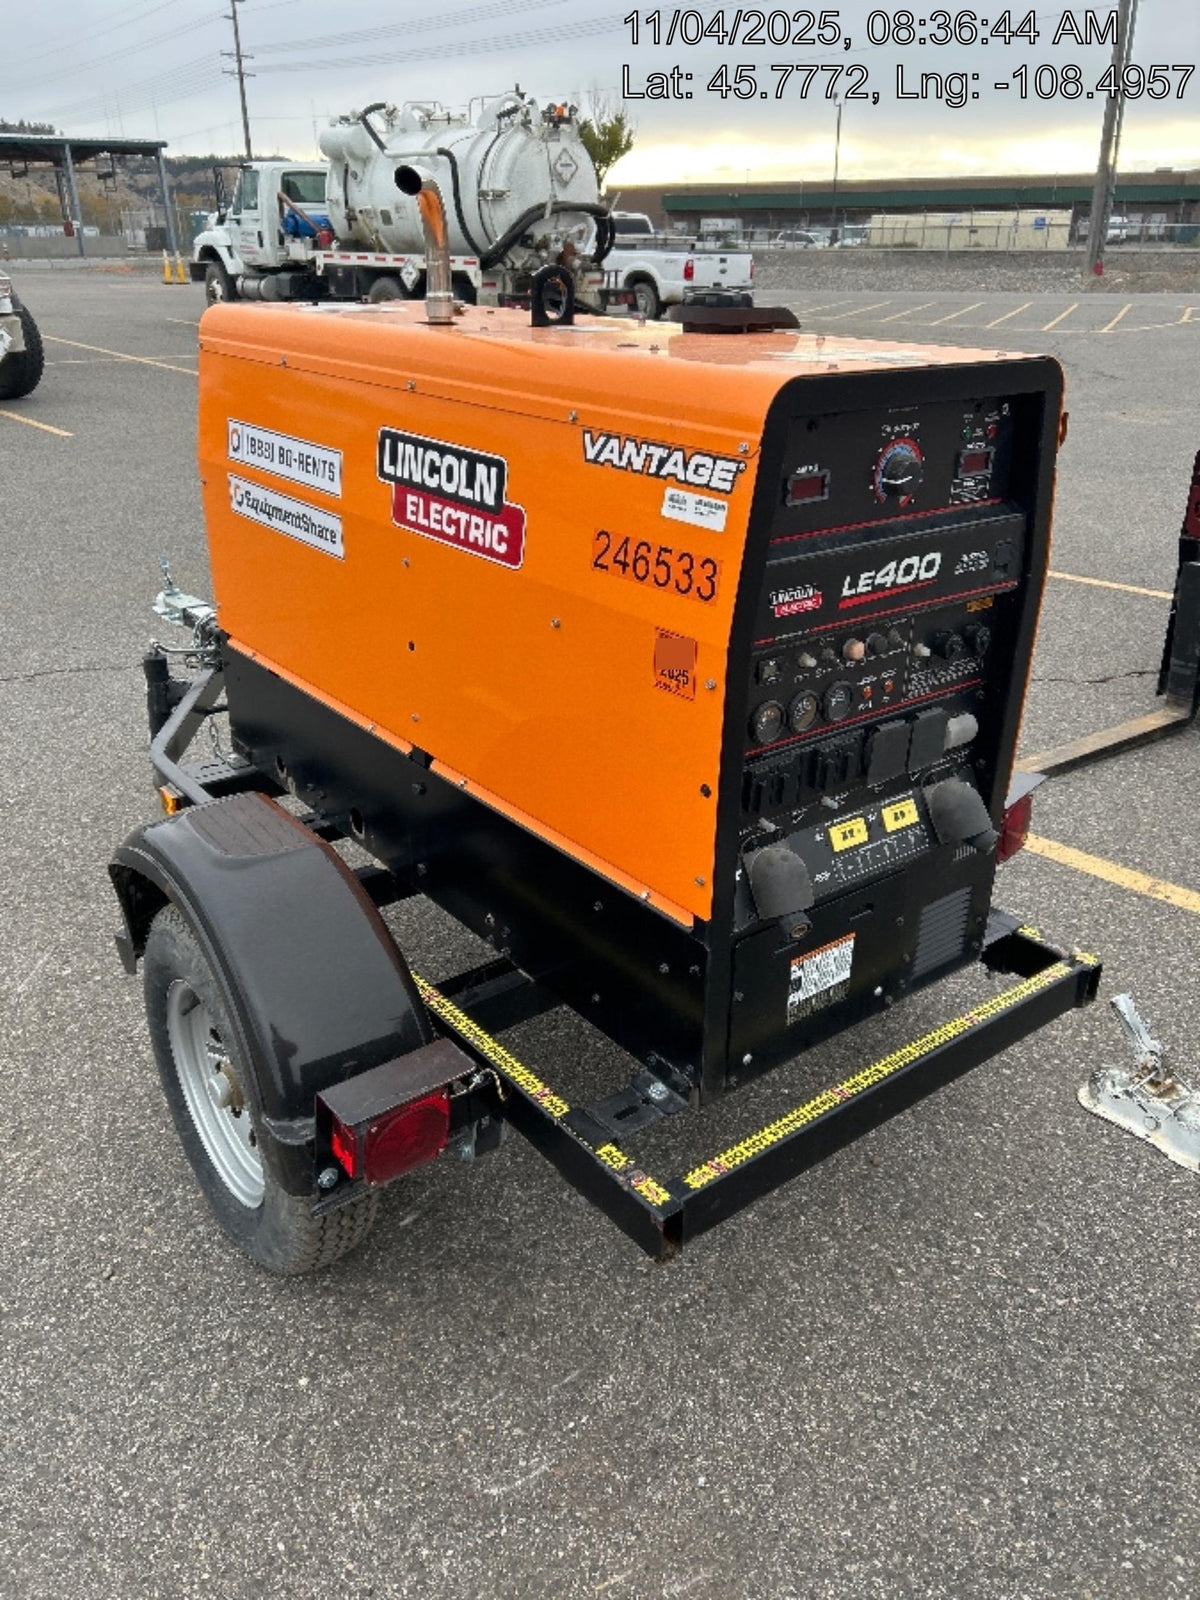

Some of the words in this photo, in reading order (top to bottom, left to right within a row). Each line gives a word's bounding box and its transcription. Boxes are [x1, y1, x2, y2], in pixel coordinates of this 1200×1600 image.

[382, 437, 498, 506] LINCOLN
[583, 431, 740, 493] VANTAGE
[245, 490, 337, 546] EquipmentShare
[405, 494, 509, 554] ELECTRIC
[592, 529, 718, 602] 246533
[840, 551, 942, 598] LE400
